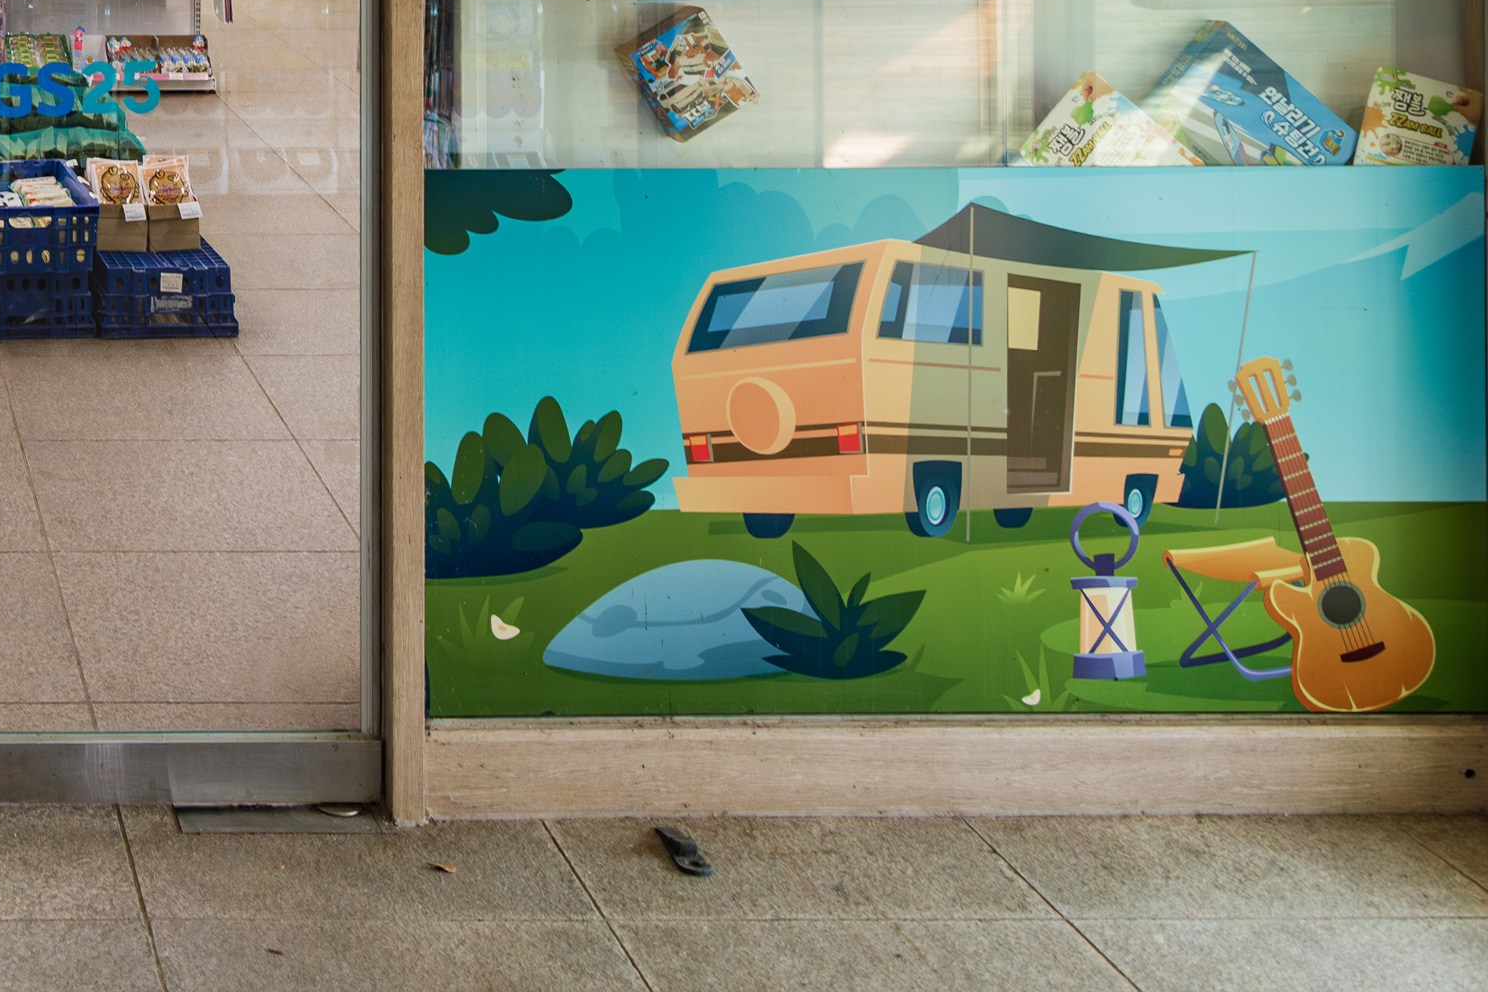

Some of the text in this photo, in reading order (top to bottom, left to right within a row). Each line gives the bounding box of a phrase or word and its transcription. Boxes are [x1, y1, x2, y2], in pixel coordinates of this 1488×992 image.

[1258, 85, 1322, 138] 연날리기
[1388, 112, 1443, 139] ZZAM BALL
[1068, 121, 1113, 167] ZZAM BALL
